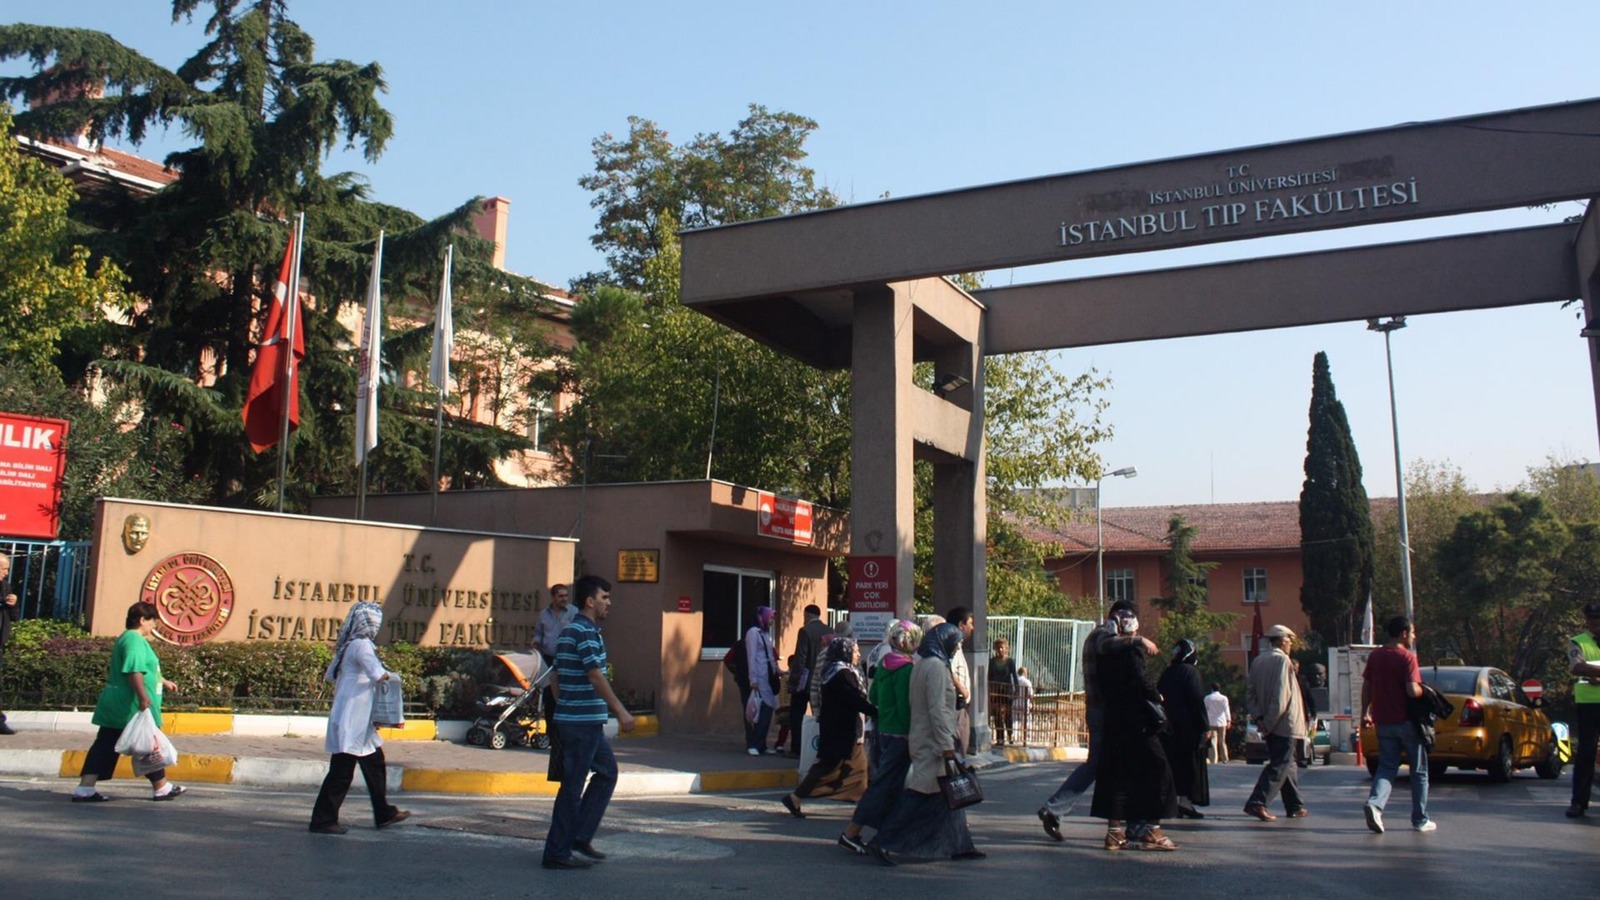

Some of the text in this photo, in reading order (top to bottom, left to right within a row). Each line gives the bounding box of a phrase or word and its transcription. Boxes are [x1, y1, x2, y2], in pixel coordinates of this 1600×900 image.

[1150, 167, 1337, 205] İSTANBUL ÜNİVERSİTESİ
[1060, 175, 1420, 246] İSTANBUL TIP FAKÜLTESİ
[403, 553, 436, 573] T.C.
[273, 575, 540, 612] İSTANBUL ÜNİVERSİTESİ
[864, 592, 880, 600] ÇOK
[247, 608, 343, 642] İSTANB
[439, 617, 536, 647] FAKÜLTE
